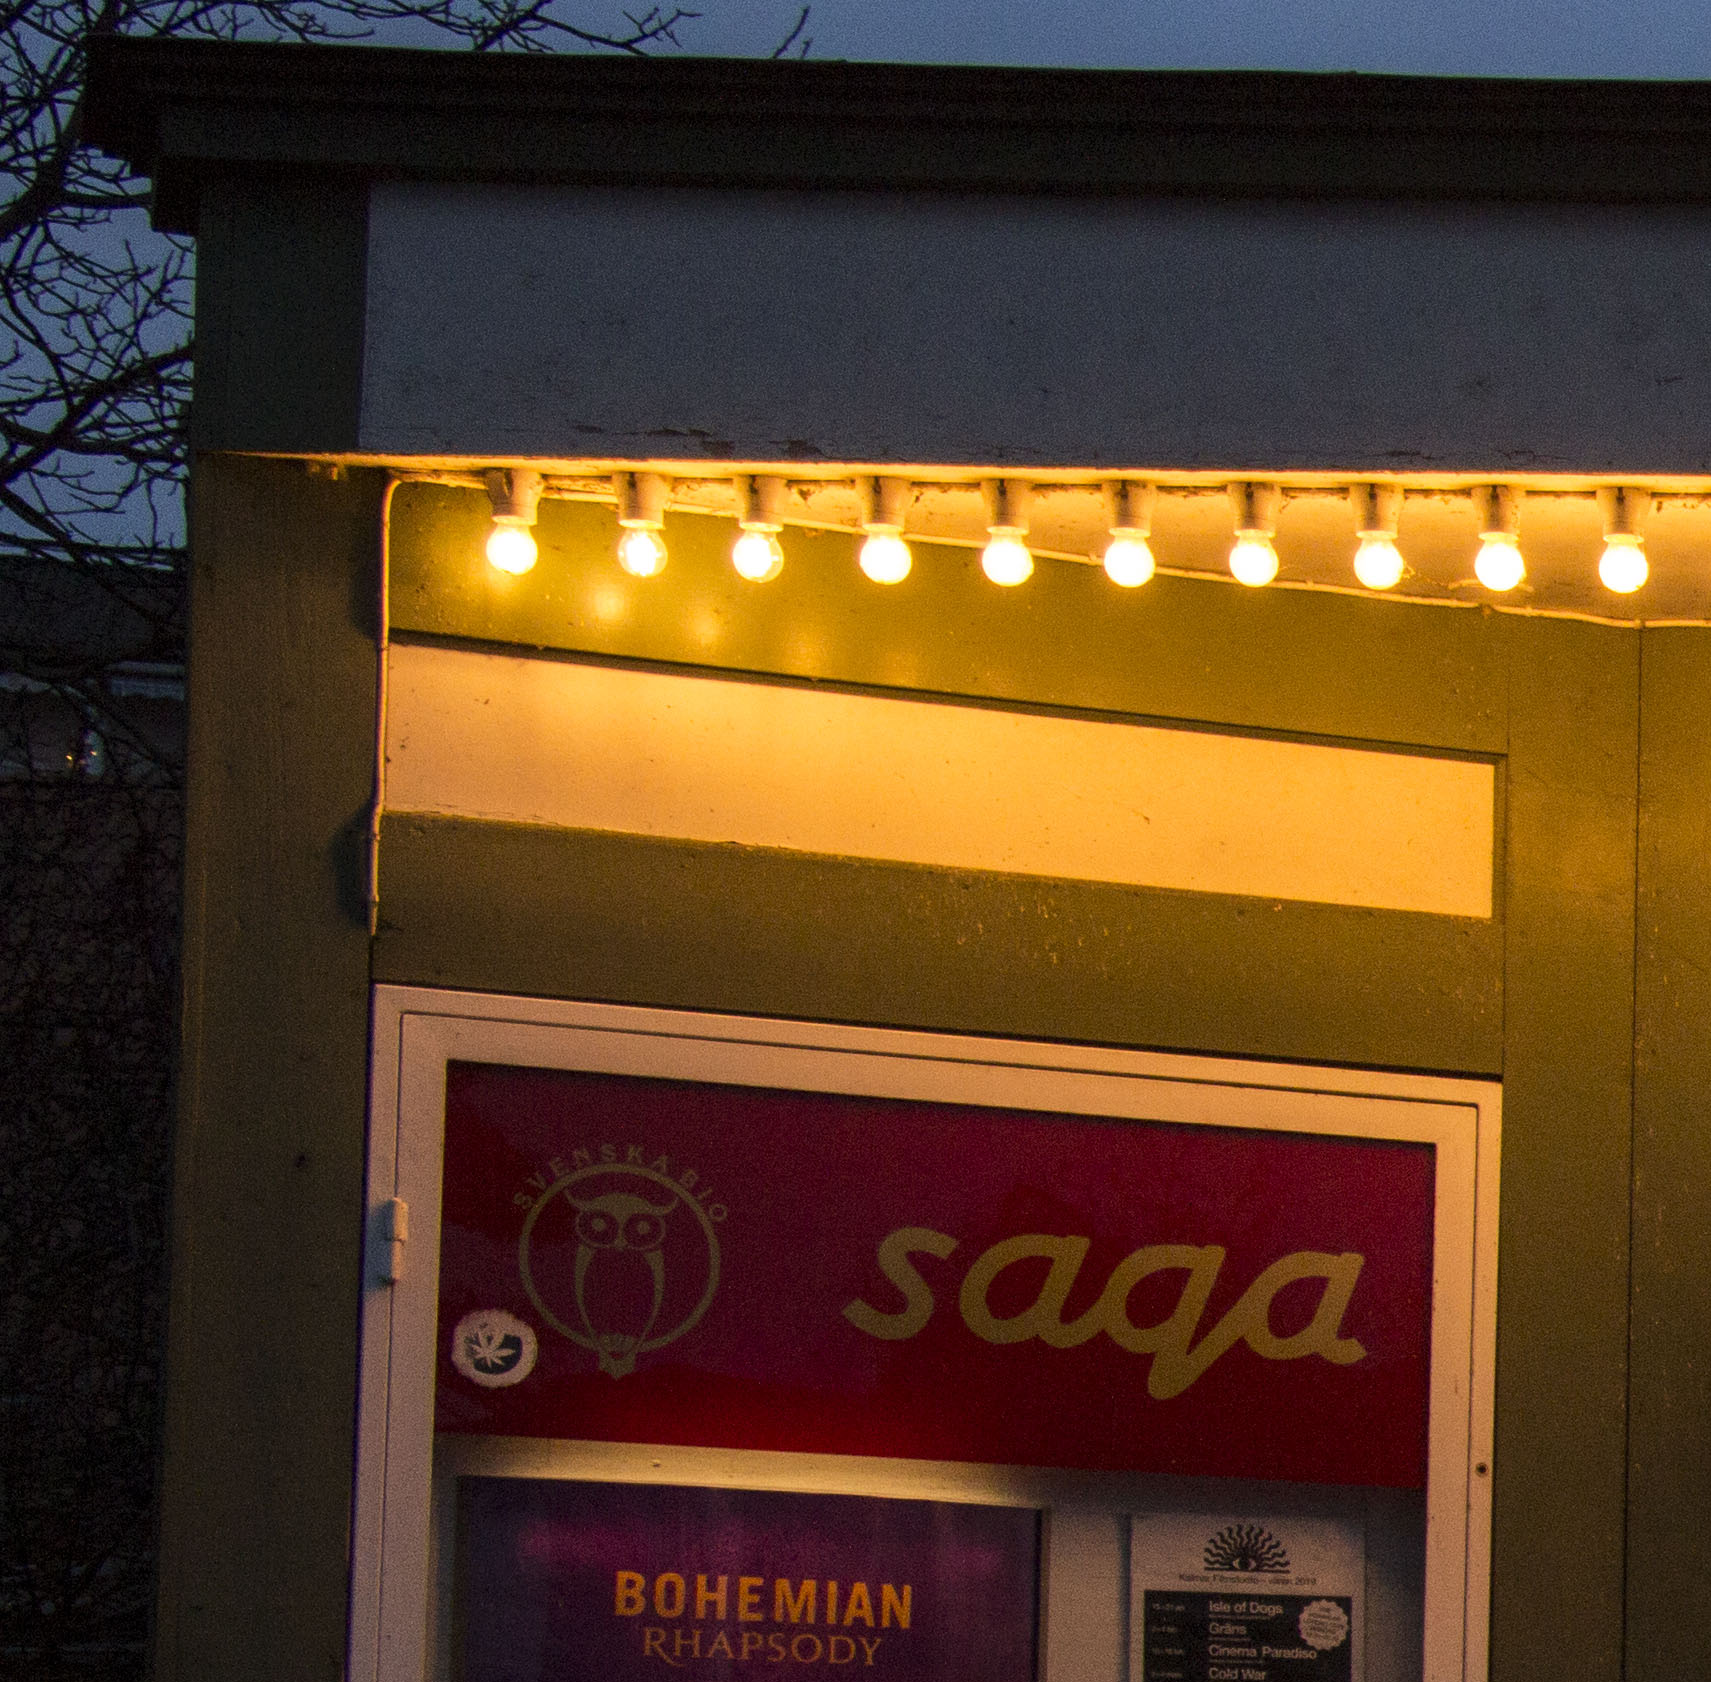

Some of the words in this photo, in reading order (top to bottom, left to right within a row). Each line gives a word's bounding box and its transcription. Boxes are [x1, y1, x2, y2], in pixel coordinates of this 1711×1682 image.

[513, 1143, 668, 1210] SVENSKA
[680, 1169, 729, 1223] BIO
[841, 1226, 1368, 1401] saga
[615, 1569, 913, 1629] BOHEMIAN
[1208, 1600, 1231, 1613] Isle
[1234, 1601, 1247, 1613] of
[1249, 1601, 1284, 1616] Dogs
[1208, 1622, 1247, 1636] Gräns
[643, 1628, 884, 1667] RHAPSODY
[1208, 1644, 1257, 1658] Cinema
[1261, 1646, 1318, 1660] Paradiso
[1208, 1667, 1238, 1680] Cold
[1241, 1668, 1267, 1681] War
